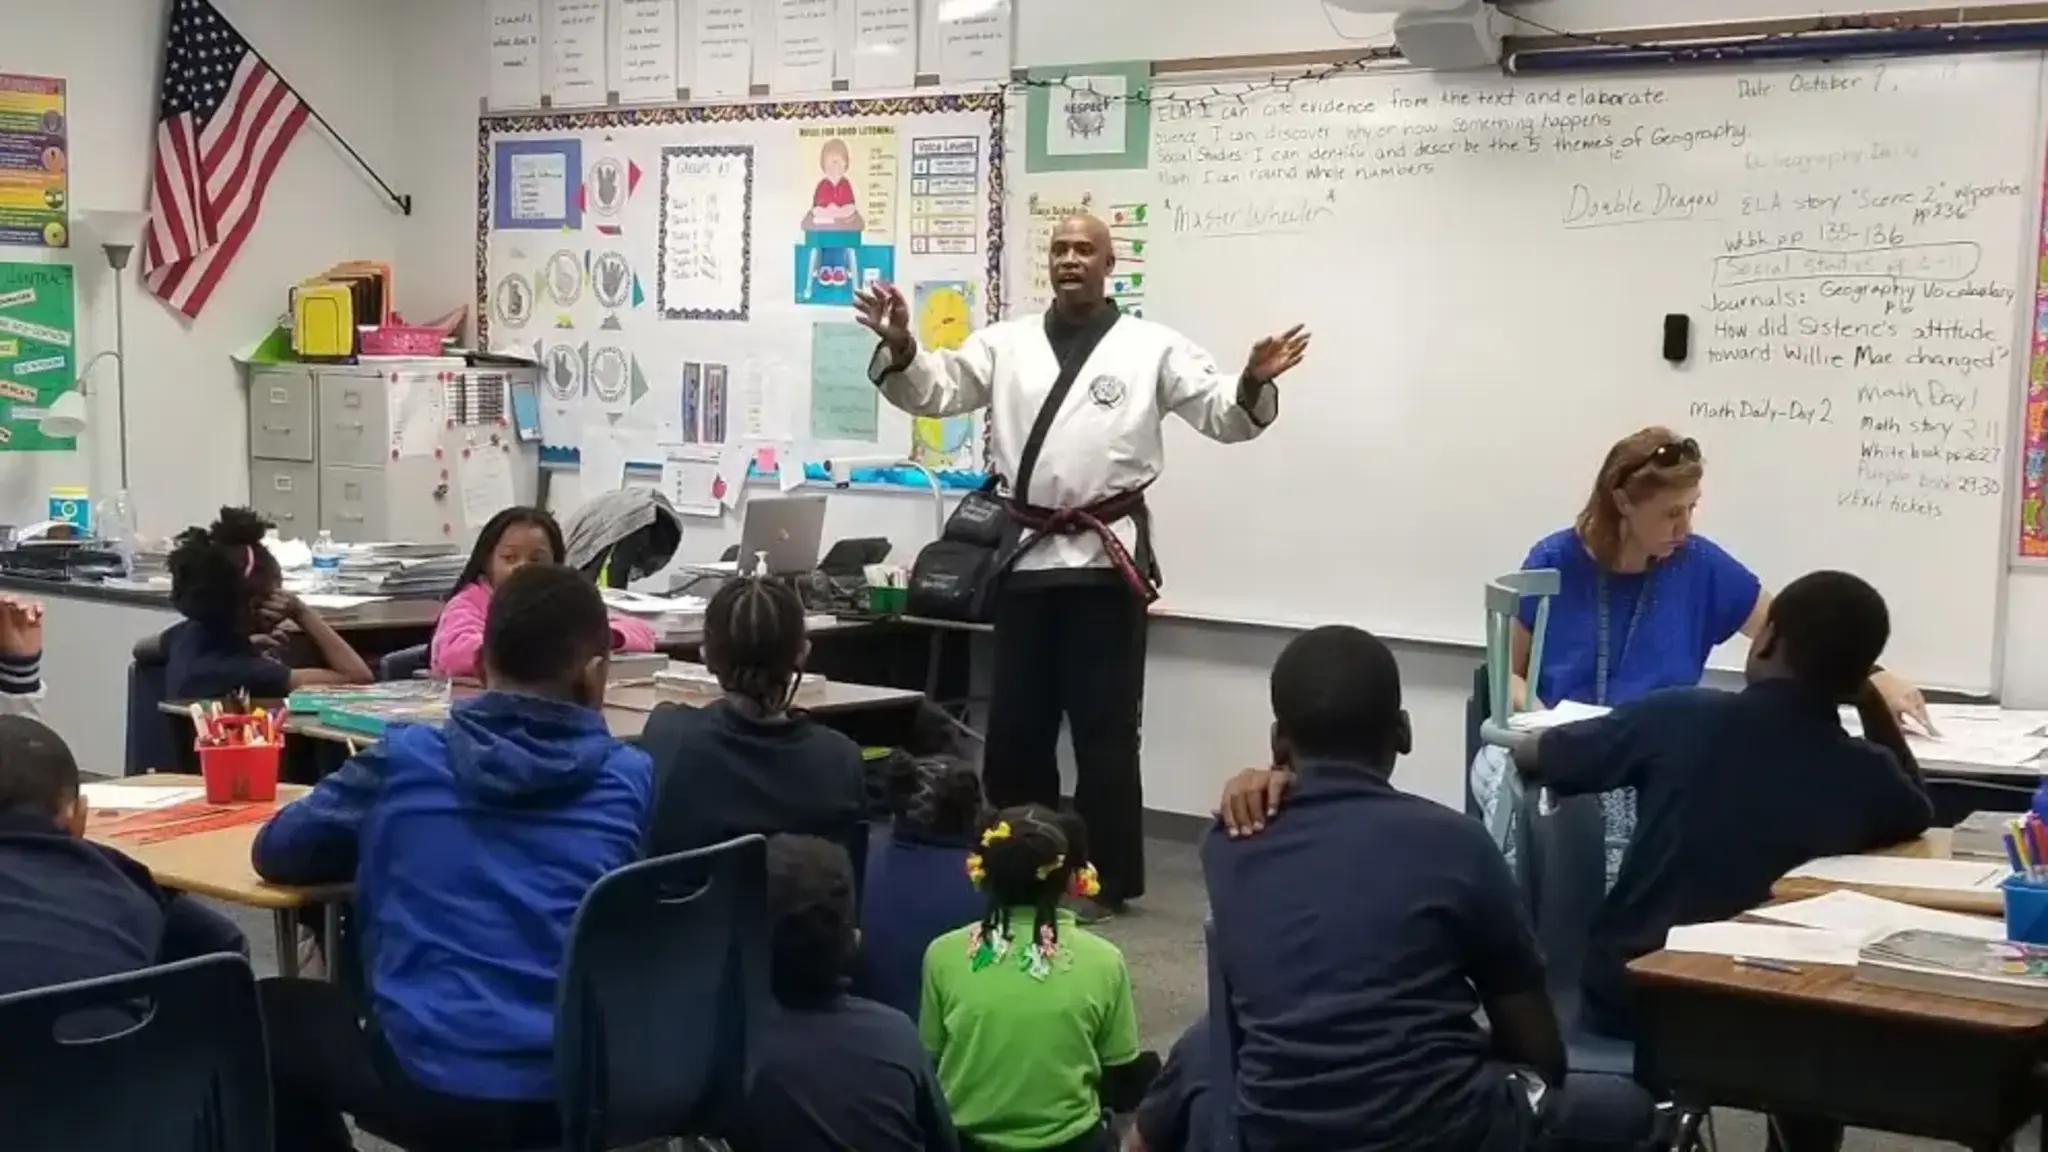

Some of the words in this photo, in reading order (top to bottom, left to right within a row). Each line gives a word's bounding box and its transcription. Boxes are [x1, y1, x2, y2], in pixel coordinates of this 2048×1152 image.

[1789, 73, 1864, 93] October
[1221, 106, 1250, 120] can
[1300, 98, 1376, 114] evidence
[1391, 88, 1428, 109] from
[1442, 90, 1469, 106] the
[1478, 87, 1516, 106] text
[1525, 88, 1561, 106] and
[1265, 123, 1329, 140] discover
[1403, 120, 1438, 136] how
[1452, 116, 1534, 136] something
[1542, 111, 1613, 132] happens
[1271, 149, 1299, 161] can
[1375, 142, 1406, 160] and
[1488, 134, 1519, 151] the
[1523, 134, 1542, 153] 5
[1552, 133, 1615, 152] themes
[1621, 125, 1645, 148] of
[1249, 165, 1297, 180] round
[1355, 162, 1435, 180] numbers
[1562, 183, 1643, 224] Double
[1741, 192, 1783, 216] ELA
[1792, 195, 1842, 217] story
[1173, 203, 1240, 233] Master
[1820, 222, 1905, 245] 135-136
[1820, 280, 1915, 304] Geography
[1715, 320, 1748, 339] How
[1758, 313, 1788, 338] did
[1913, 317, 1999, 342] attitude
[1708, 345, 1771, 364] toward
[1783, 347, 1845, 368] Willie
[1853, 345, 1893, 368] Mae
[1857, 383, 1920, 408] Math
[1927, 379, 1966, 411] Day
[1690, 401, 1735, 419] Math
[1819, 397, 1834, 425] 2
[1859, 415, 1901, 434] Math
[1909, 416, 1953, 441] story
[1861, 441, 1905, 459] White
